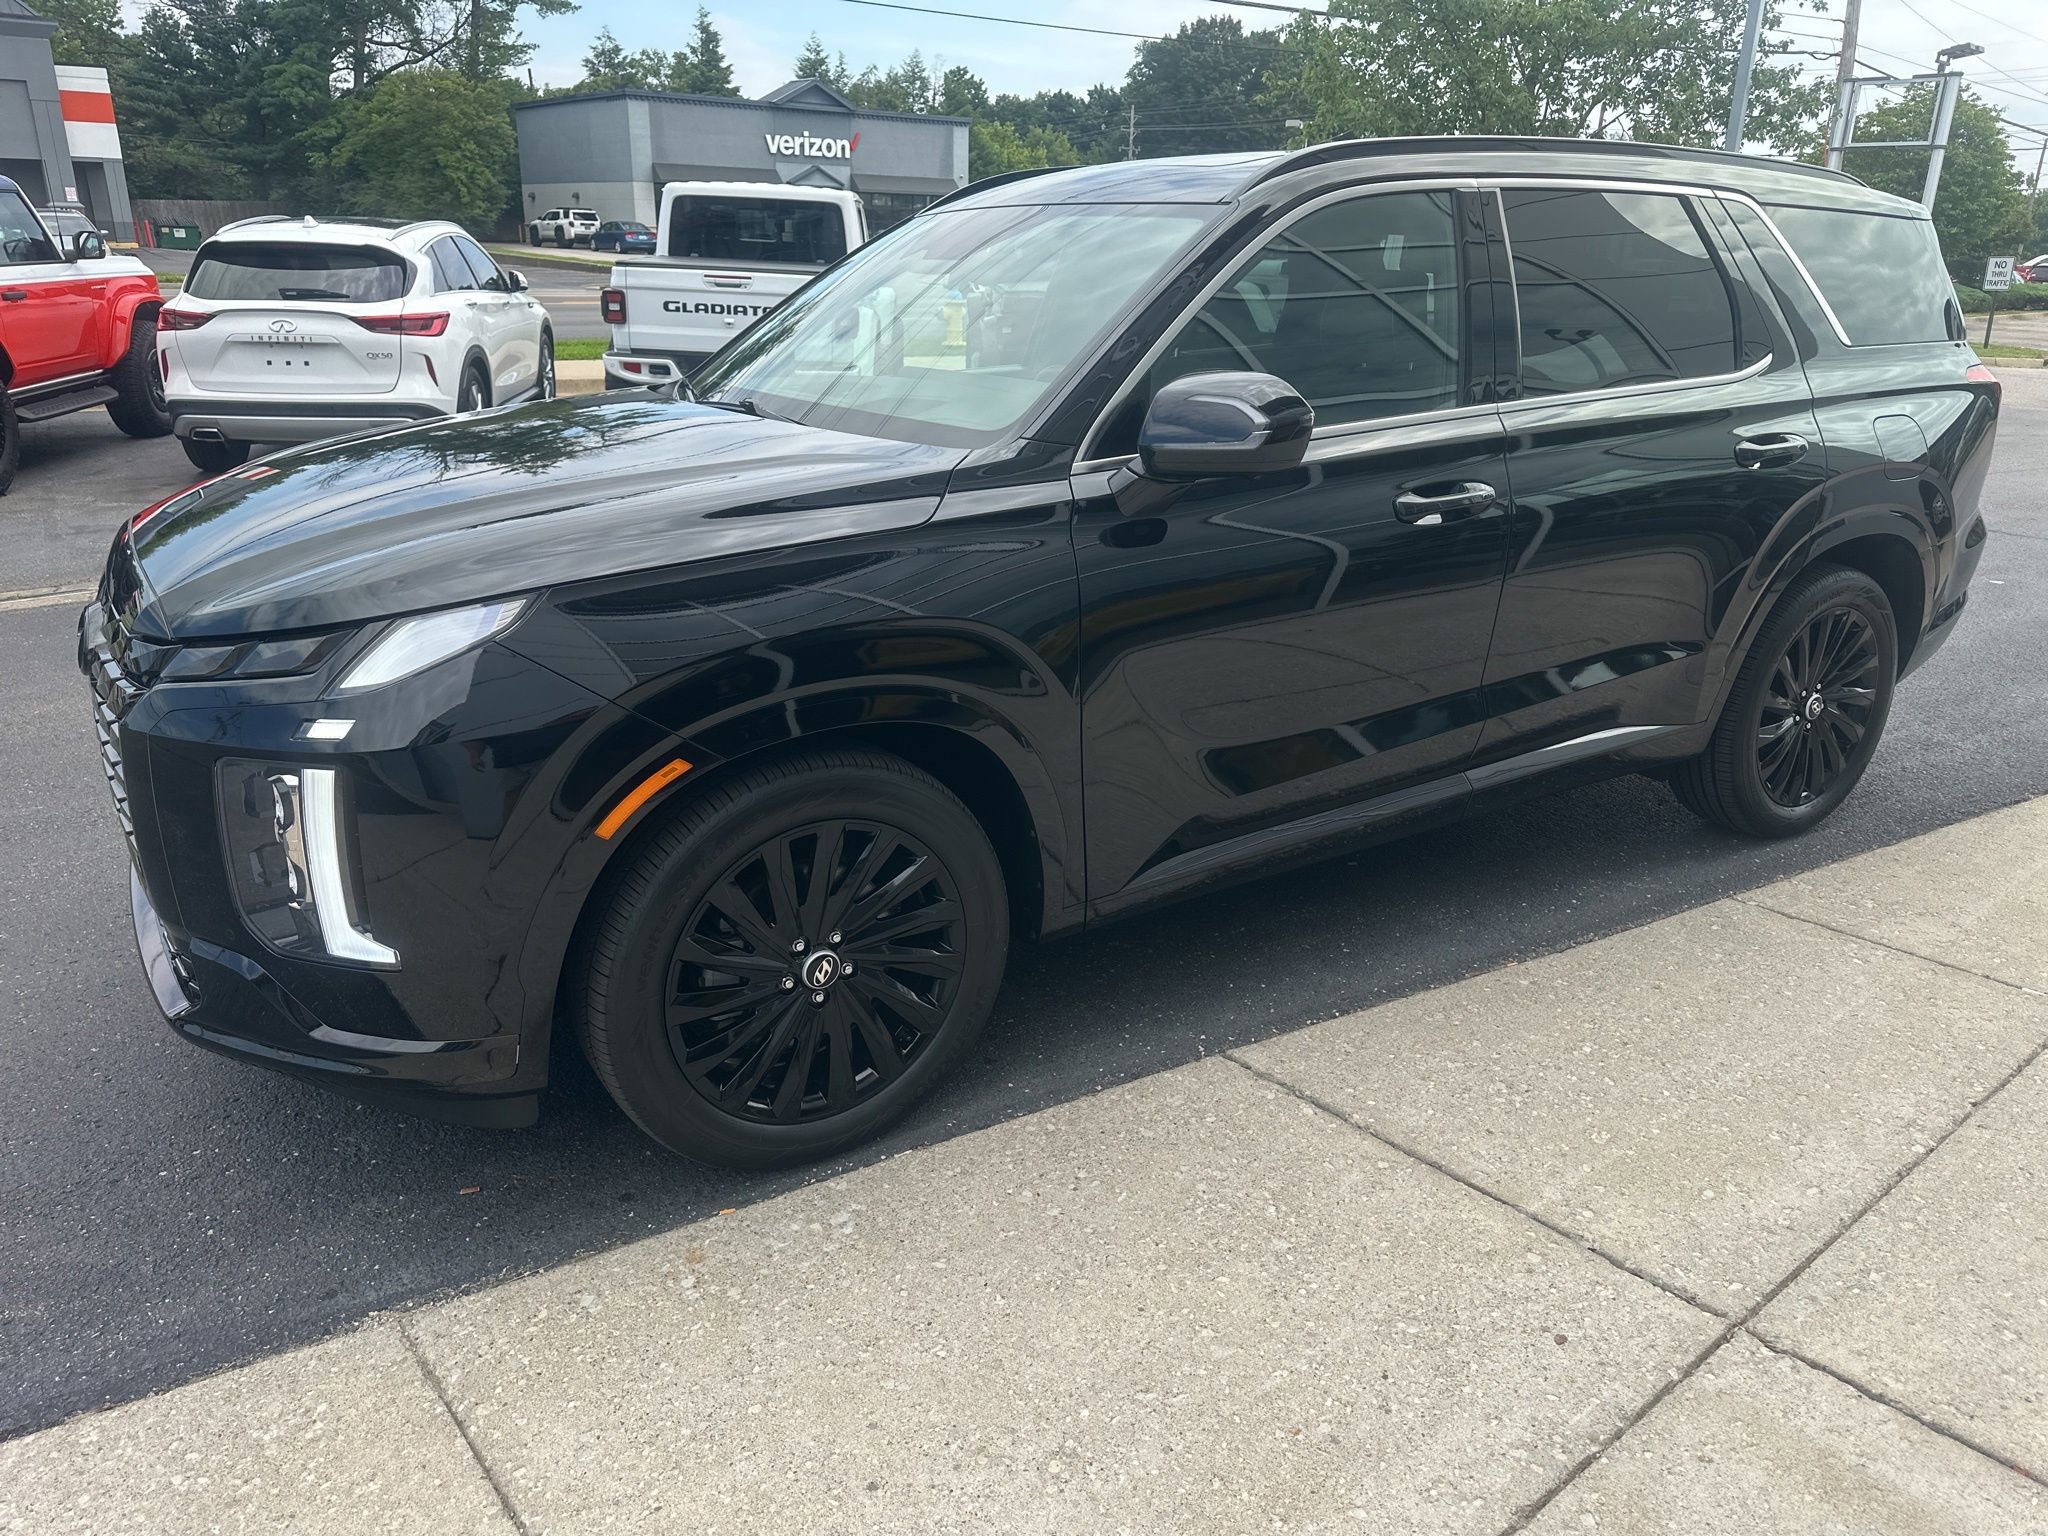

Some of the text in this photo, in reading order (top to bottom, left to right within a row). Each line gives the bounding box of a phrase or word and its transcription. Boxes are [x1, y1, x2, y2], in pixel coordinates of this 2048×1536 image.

[765, 131, 851, 158] verizon
[1994, 261, 2007, 269] NO
[366, 352, 393, 360] QX50
